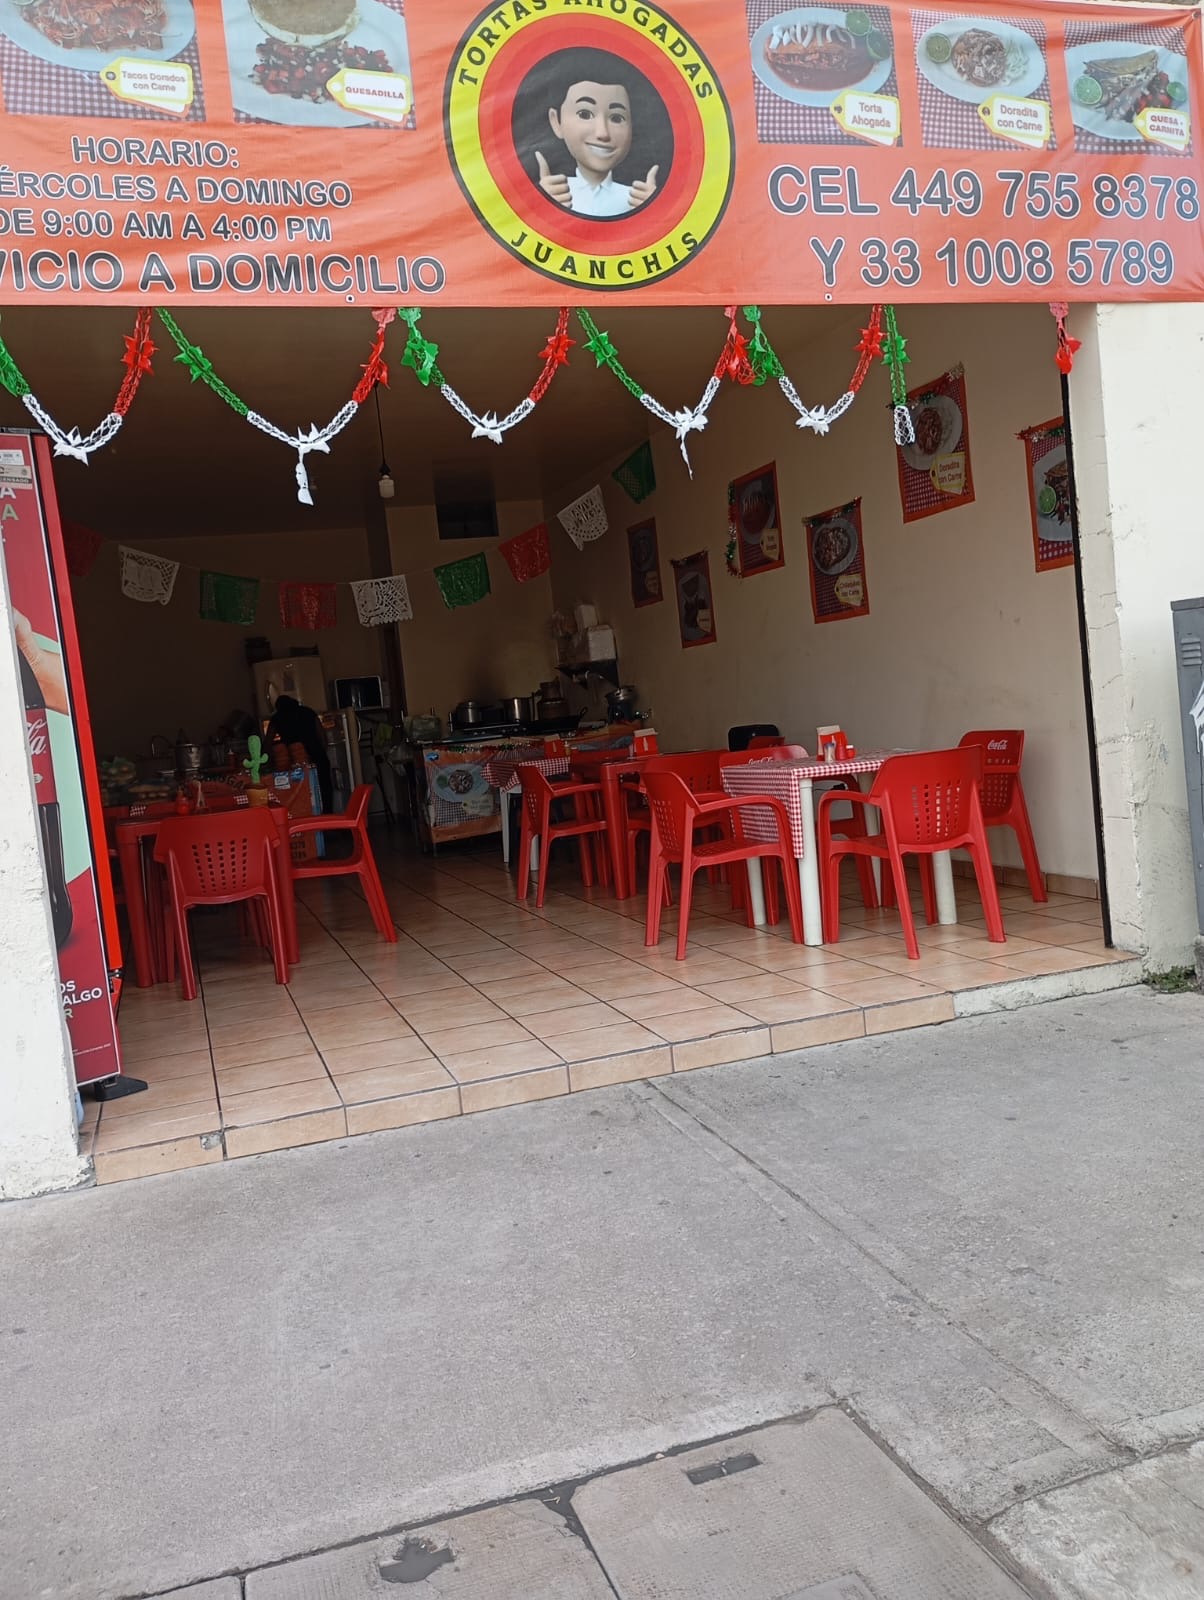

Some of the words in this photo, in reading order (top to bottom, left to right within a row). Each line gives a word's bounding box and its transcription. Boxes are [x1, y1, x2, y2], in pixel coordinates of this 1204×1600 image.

[459, 0, 548, 87] TORTAS
[563, 0, 714, 99] OGADAS
[122, 71, 148, 80] Tacos
[150, 73, 186, 82] Dorados
[133, 82, 149, 90] con
[151, 83, 177, 92] Carne
[345, 86, 405, 99] QUESADILLA
[851, 115, 892, 128] Ahogada
[859, 102, 883, 113] Torta
[1000, 104, 1038, 118] Doradita
[997, 119, 1014, 128] con
[1016, 120, 1043, 131] Carne
[71, 135, 240, 168] HORARIO:
[166, 176, 190, 203] A
[198, 177, 352, 208] DOMINGO
[767, 164, 879, 216] CEL
[890, 168, 982, 217] 449
[997, 170, 1080, 220] 755
[1092, 172, 1198, 221] 8378
[42, 208, 114, 238] 9:00
[123, 211, 172, 240] AM
[182, 213, 205, 241] A
[213, 214, 278, 242] 4:00
[287, 216, 332, 242] PM
[0, 249, 125, 293] ICIO
[139, 252, 177, 293] A
[189, 252, 446, 294] DOMICILIO
[511, 231, 699, 280] JUANCHIS
[809, 236, 845, 288] Y
[860, 237, 921, 287] 33
[935, 238, 1054, 287] 1008
[1066, 239, 1175, 286] 5789
